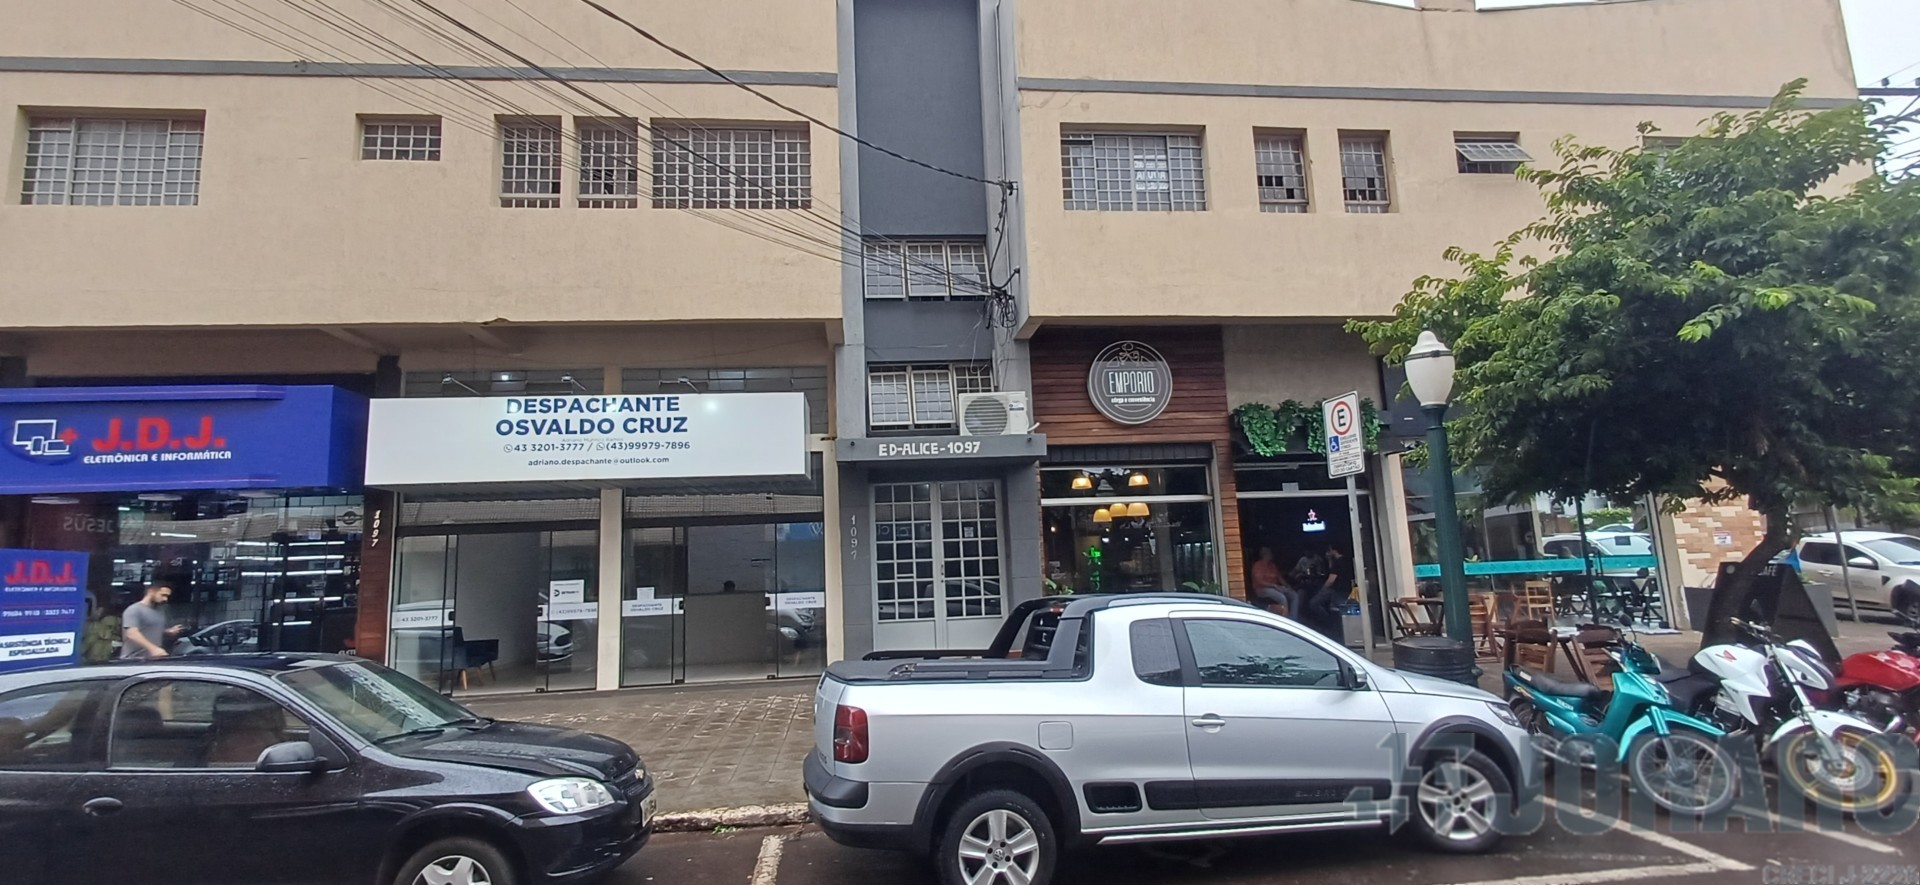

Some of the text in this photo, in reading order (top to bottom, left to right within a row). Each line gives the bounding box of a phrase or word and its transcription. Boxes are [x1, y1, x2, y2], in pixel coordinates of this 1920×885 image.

[1108, 370, 1154, 394] EMPORIO
[507, 396, 680, 414] DESPACHANTE
[496, 416, 688, 436] OSVALDO CRUZ
[1337, 409, 1347, 427] E
[91, 415, 227, 451] J.D.J.
[83, 450, 231, 464] ELETRÔNICA E INFORMÁTICA
[514, 443, 527, 452] 43
[531, 443, 584, 452] 3201-3777
[606, 441, 691, 451] (43)99979-7896
[371, 509, 382, 548] 1097
[850, 515, 858, 560] 1097
[4, 561, 78, 584] J.D.J.
